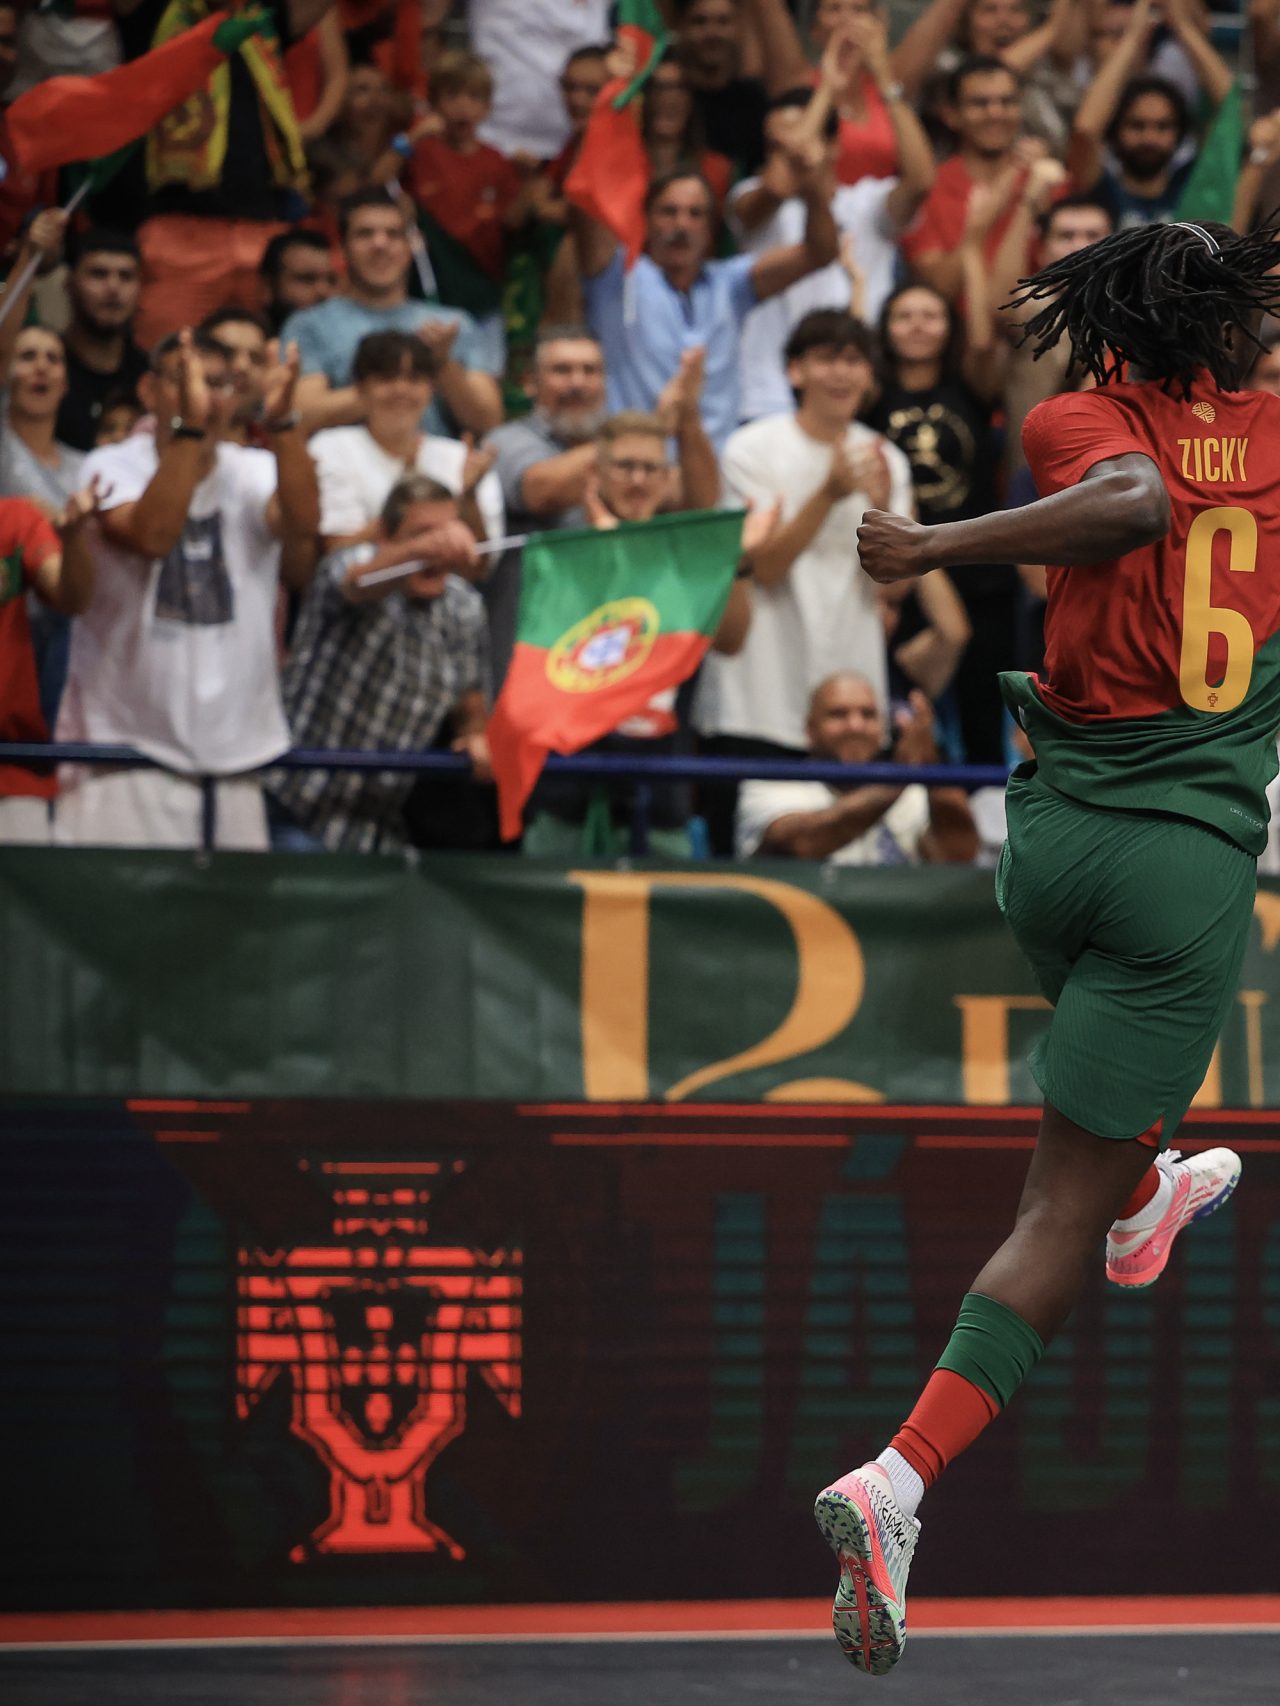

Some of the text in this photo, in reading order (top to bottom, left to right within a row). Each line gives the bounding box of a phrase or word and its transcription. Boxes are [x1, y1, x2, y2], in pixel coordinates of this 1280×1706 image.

[1177, 436, 1249, 483] ZICKY
[1179, 506, 1258, 713] 6
[672, 1136, 918, 1514] JÁ
